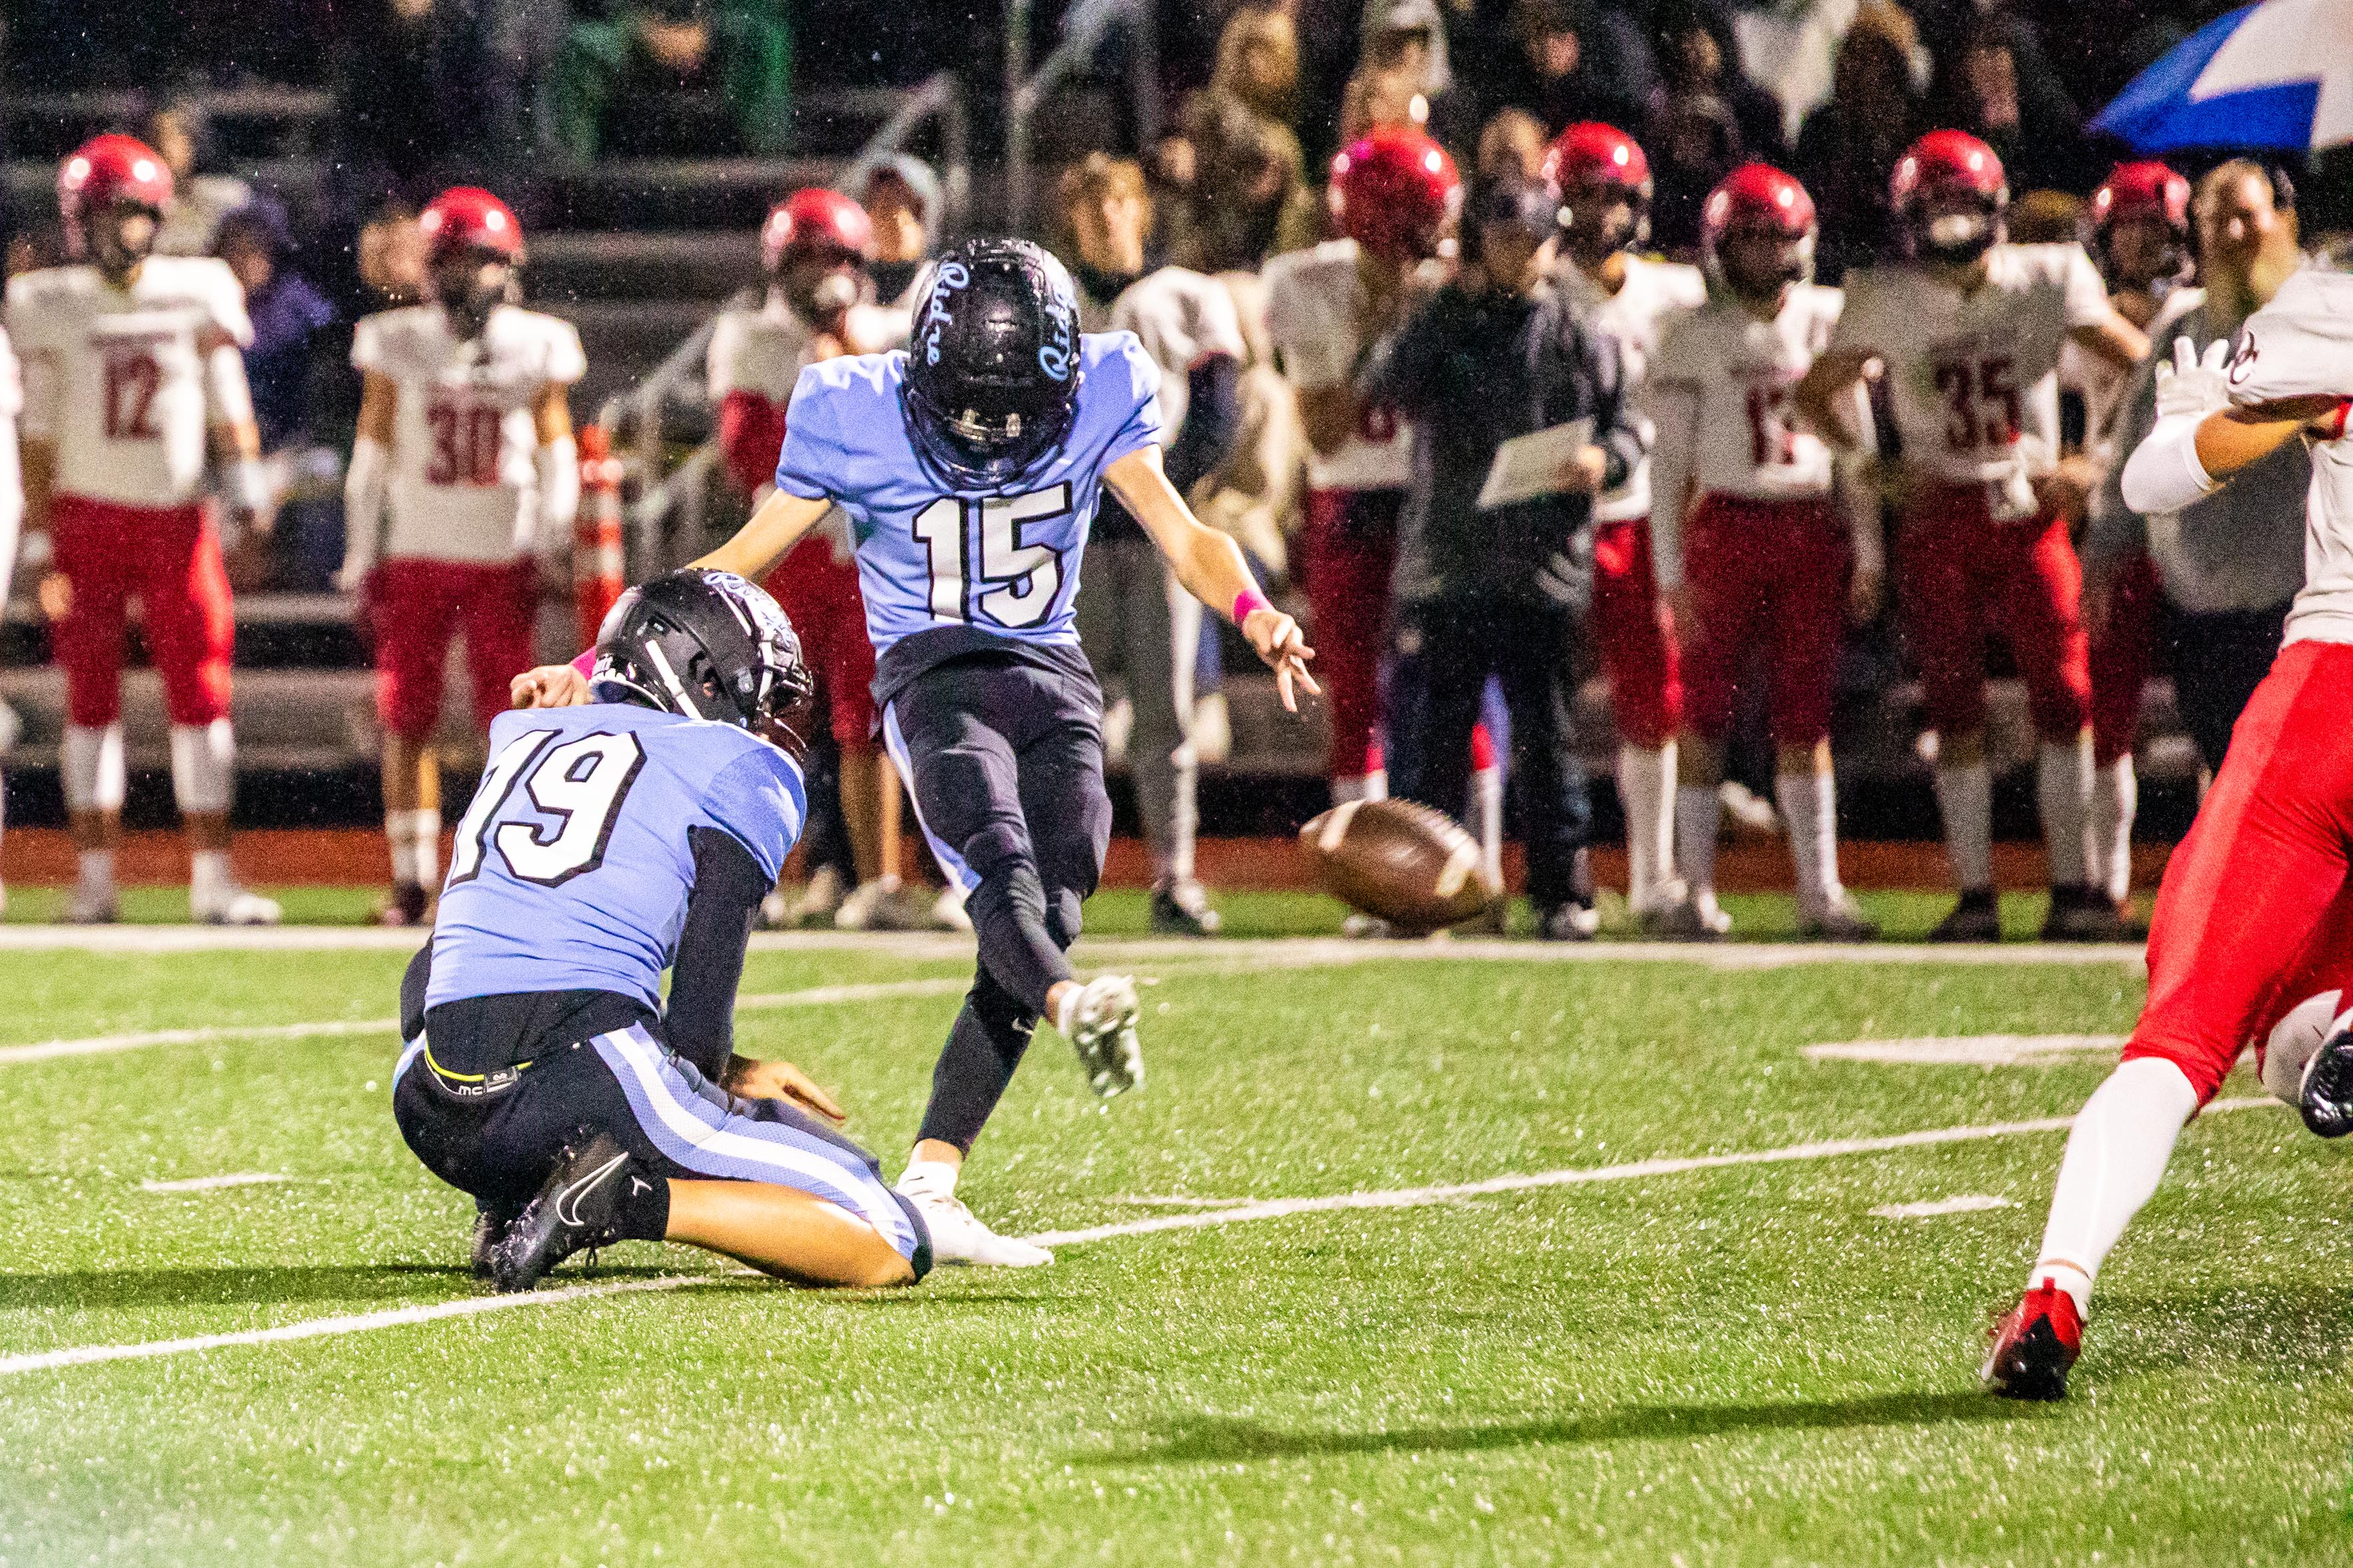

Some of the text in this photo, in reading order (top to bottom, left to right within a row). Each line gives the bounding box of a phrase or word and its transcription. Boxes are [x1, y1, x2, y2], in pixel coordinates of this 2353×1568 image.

[425, 403, 501, 489] 30
[1934, 358, 2020, 449] 35
[912, 477, 1073, 630] 15
[446, 728, 648, 890] 19
